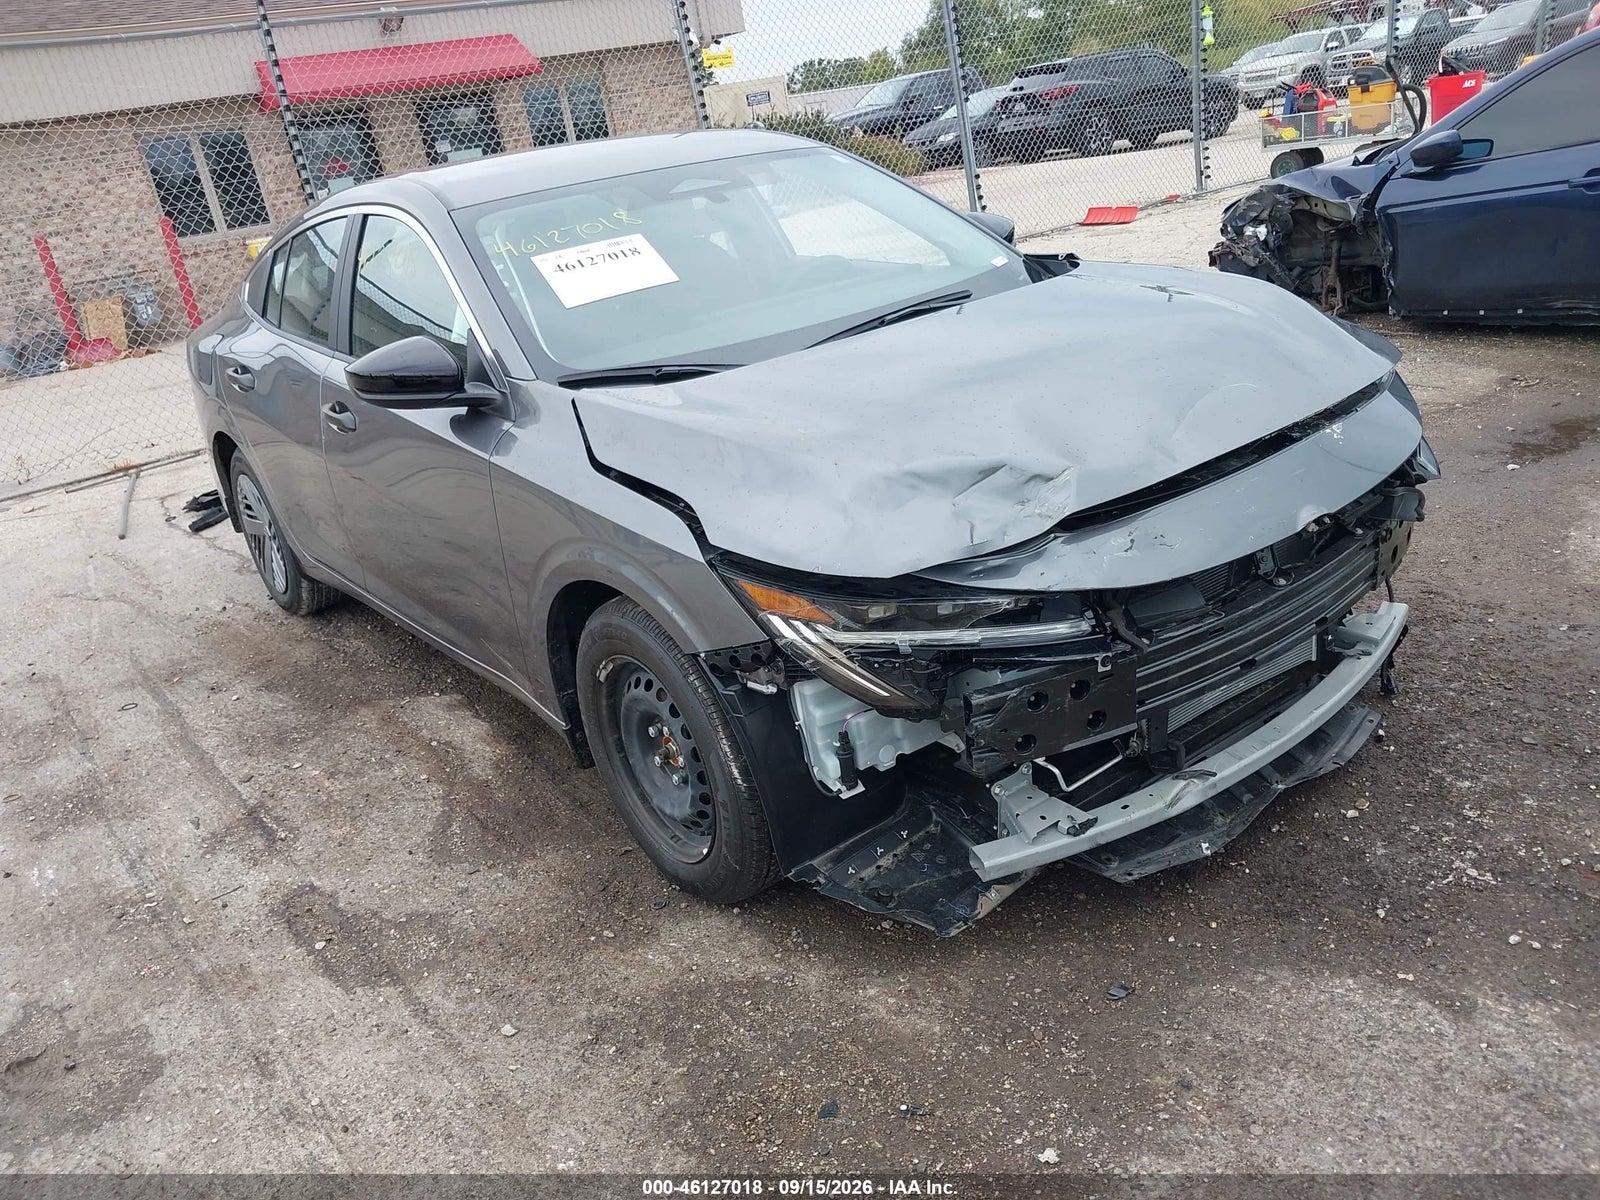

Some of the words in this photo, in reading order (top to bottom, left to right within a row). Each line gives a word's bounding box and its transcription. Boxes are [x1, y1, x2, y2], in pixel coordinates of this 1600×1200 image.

[1461, 79, 1477, 89] ACE
[494, 208, 642, 256] 46127018
[554, 247, 641, 272] 46127018
